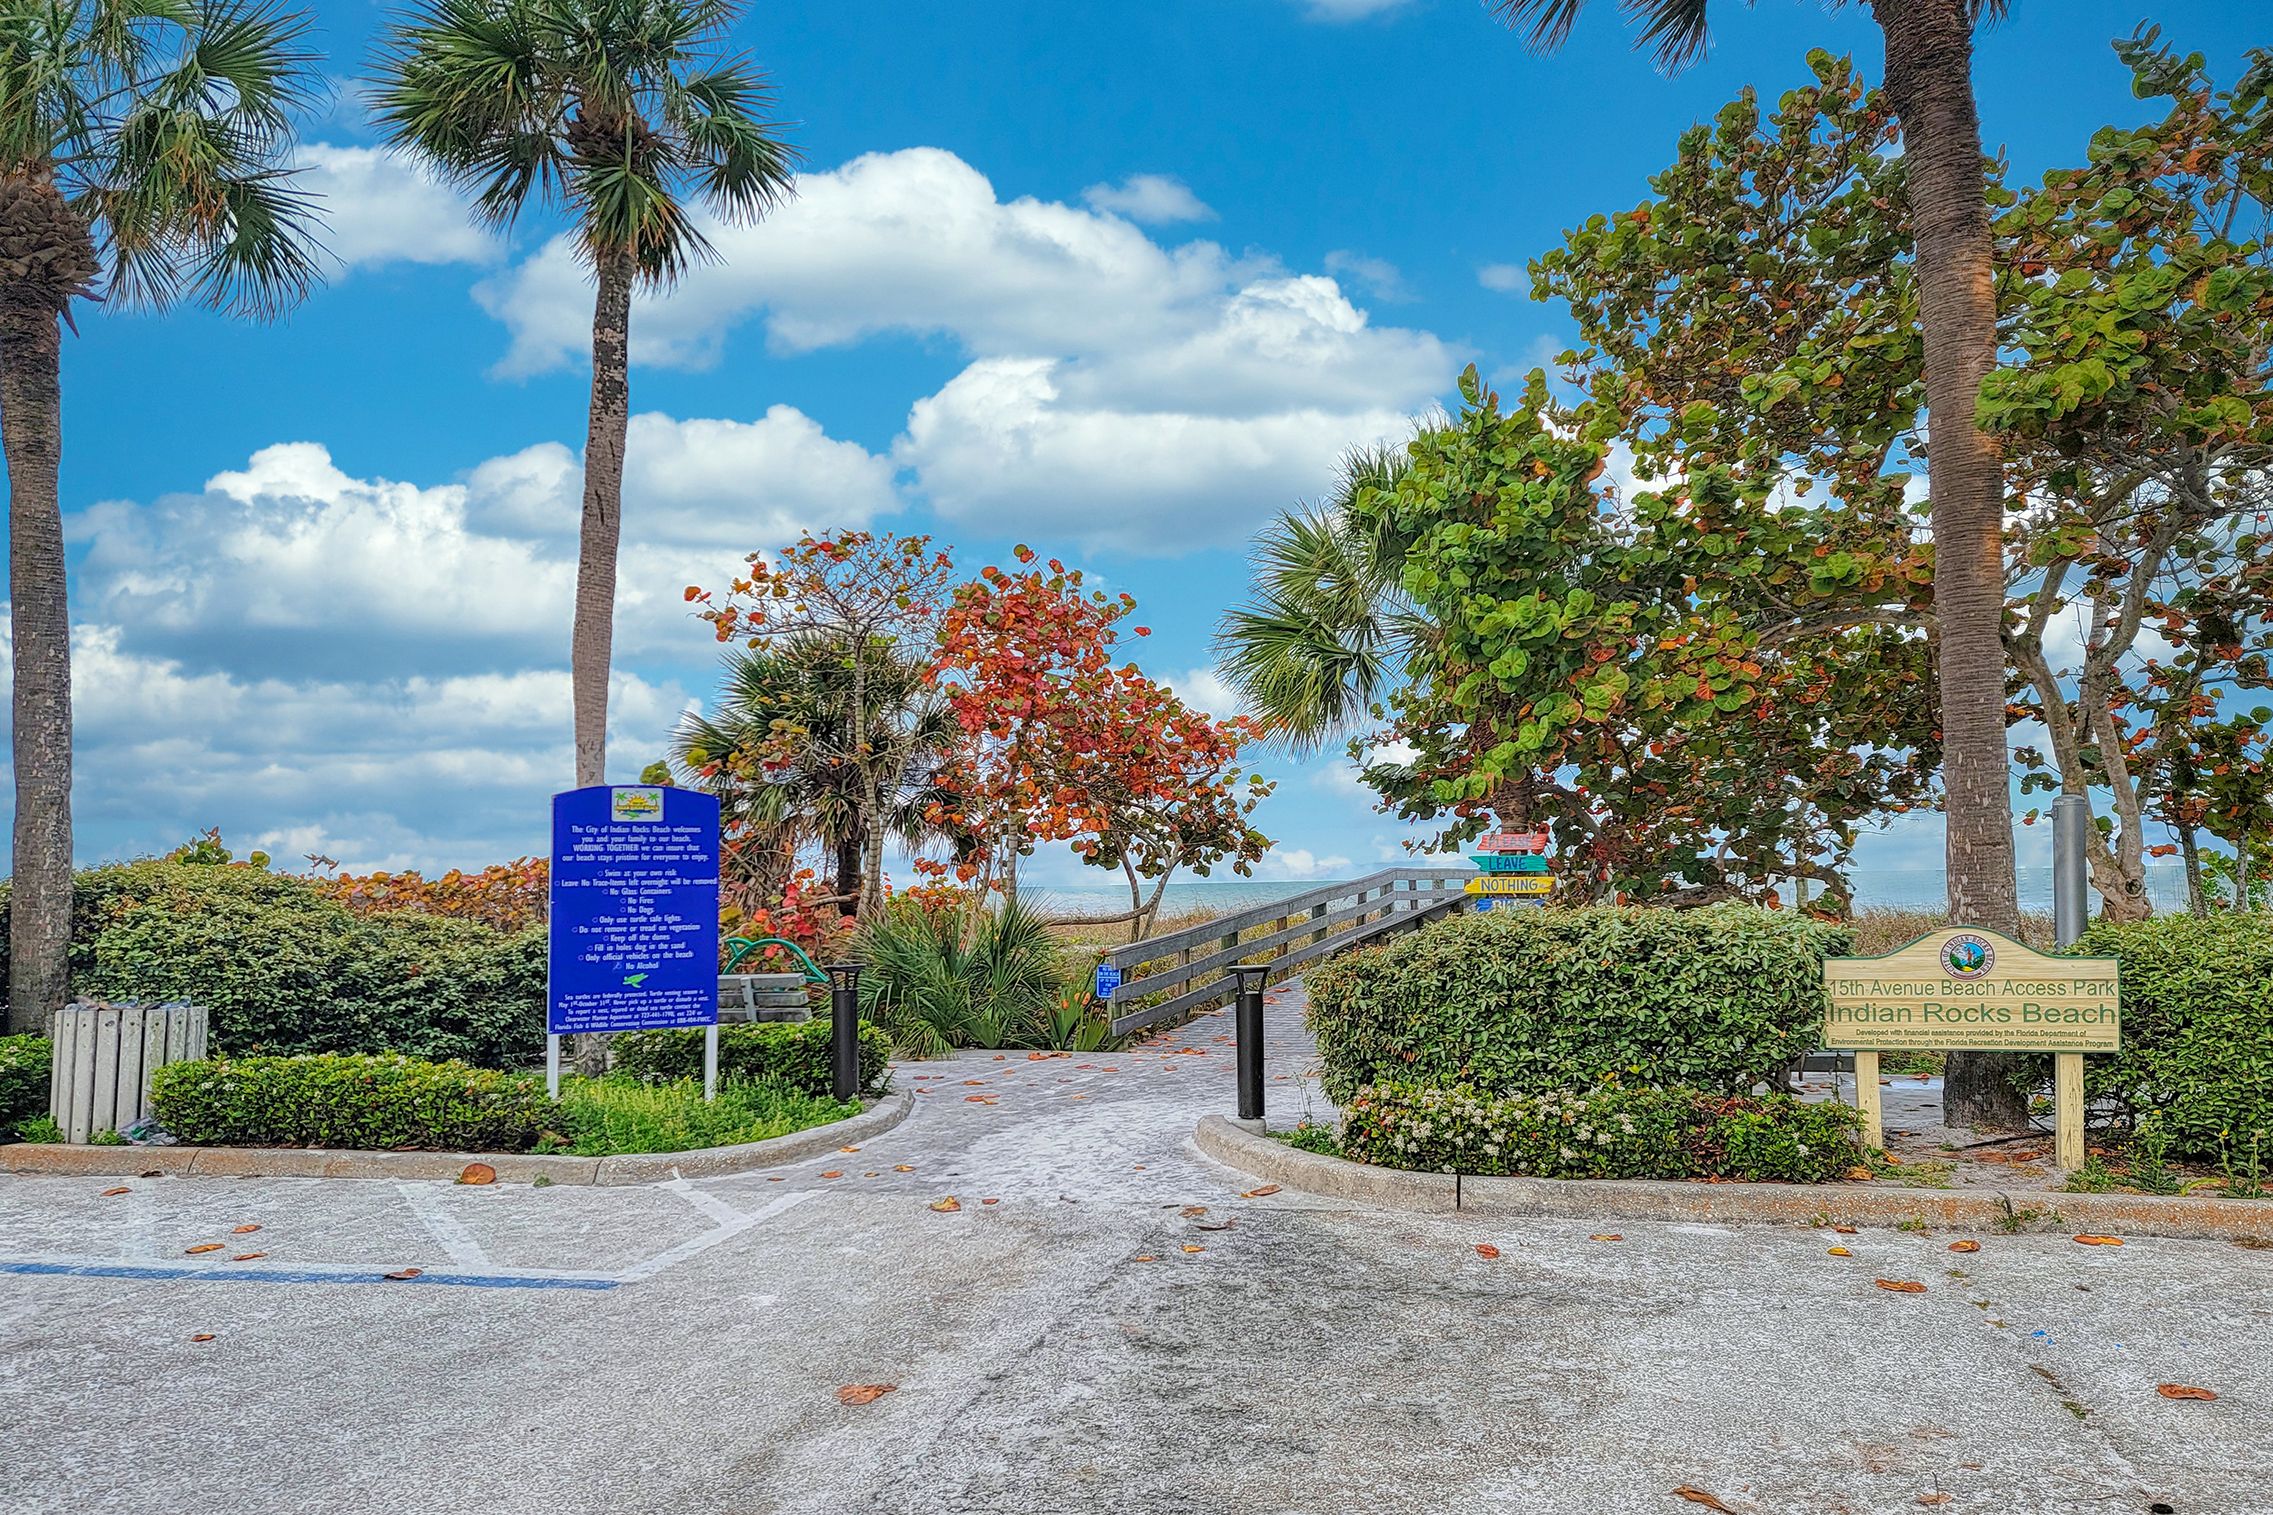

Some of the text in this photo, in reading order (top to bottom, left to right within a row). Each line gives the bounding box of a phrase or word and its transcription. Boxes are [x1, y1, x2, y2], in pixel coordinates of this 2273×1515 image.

[586, 826, 598, 835] City
[628, 835, 647, 844] family
[573, 844, 604, 852] WORKING
[606, 844, 639, 852] TOGETHER
[1489, 856, 1528, 870] LEAVE
[641, 878, 668, 887] overnight
[1481, 879, 1538, 892] NOTHING
[639, 906, 654, 915] Dogs
[599, 916, 614, 925] Only
[664, 914, 681, 924] lights
[579, 926, 588, 934] Do
[669, 924, 700, 933] vegetation
[610, 934, 626, 943] Keep
[585, 954, 600, 962] Only
[602, 953, 623, 961] official
[1830, 980, 2115, 996] 15th Avenue Beach Access Park
[1830, 1003, 2116, 1023] Indian Rocks Beach
[1856, 1029, 1888, 1037] Developed
[1966, 1030, 1993, 1038] provided
[1995, 1030, 2003, 1038] by
[2040, 1030, 2078, 1039] Department
[1908, 1038, 1933, 1047] through
[2004, 1039, 2047, 1048] Development
[2085, 1040, 2114, 1048] Program
